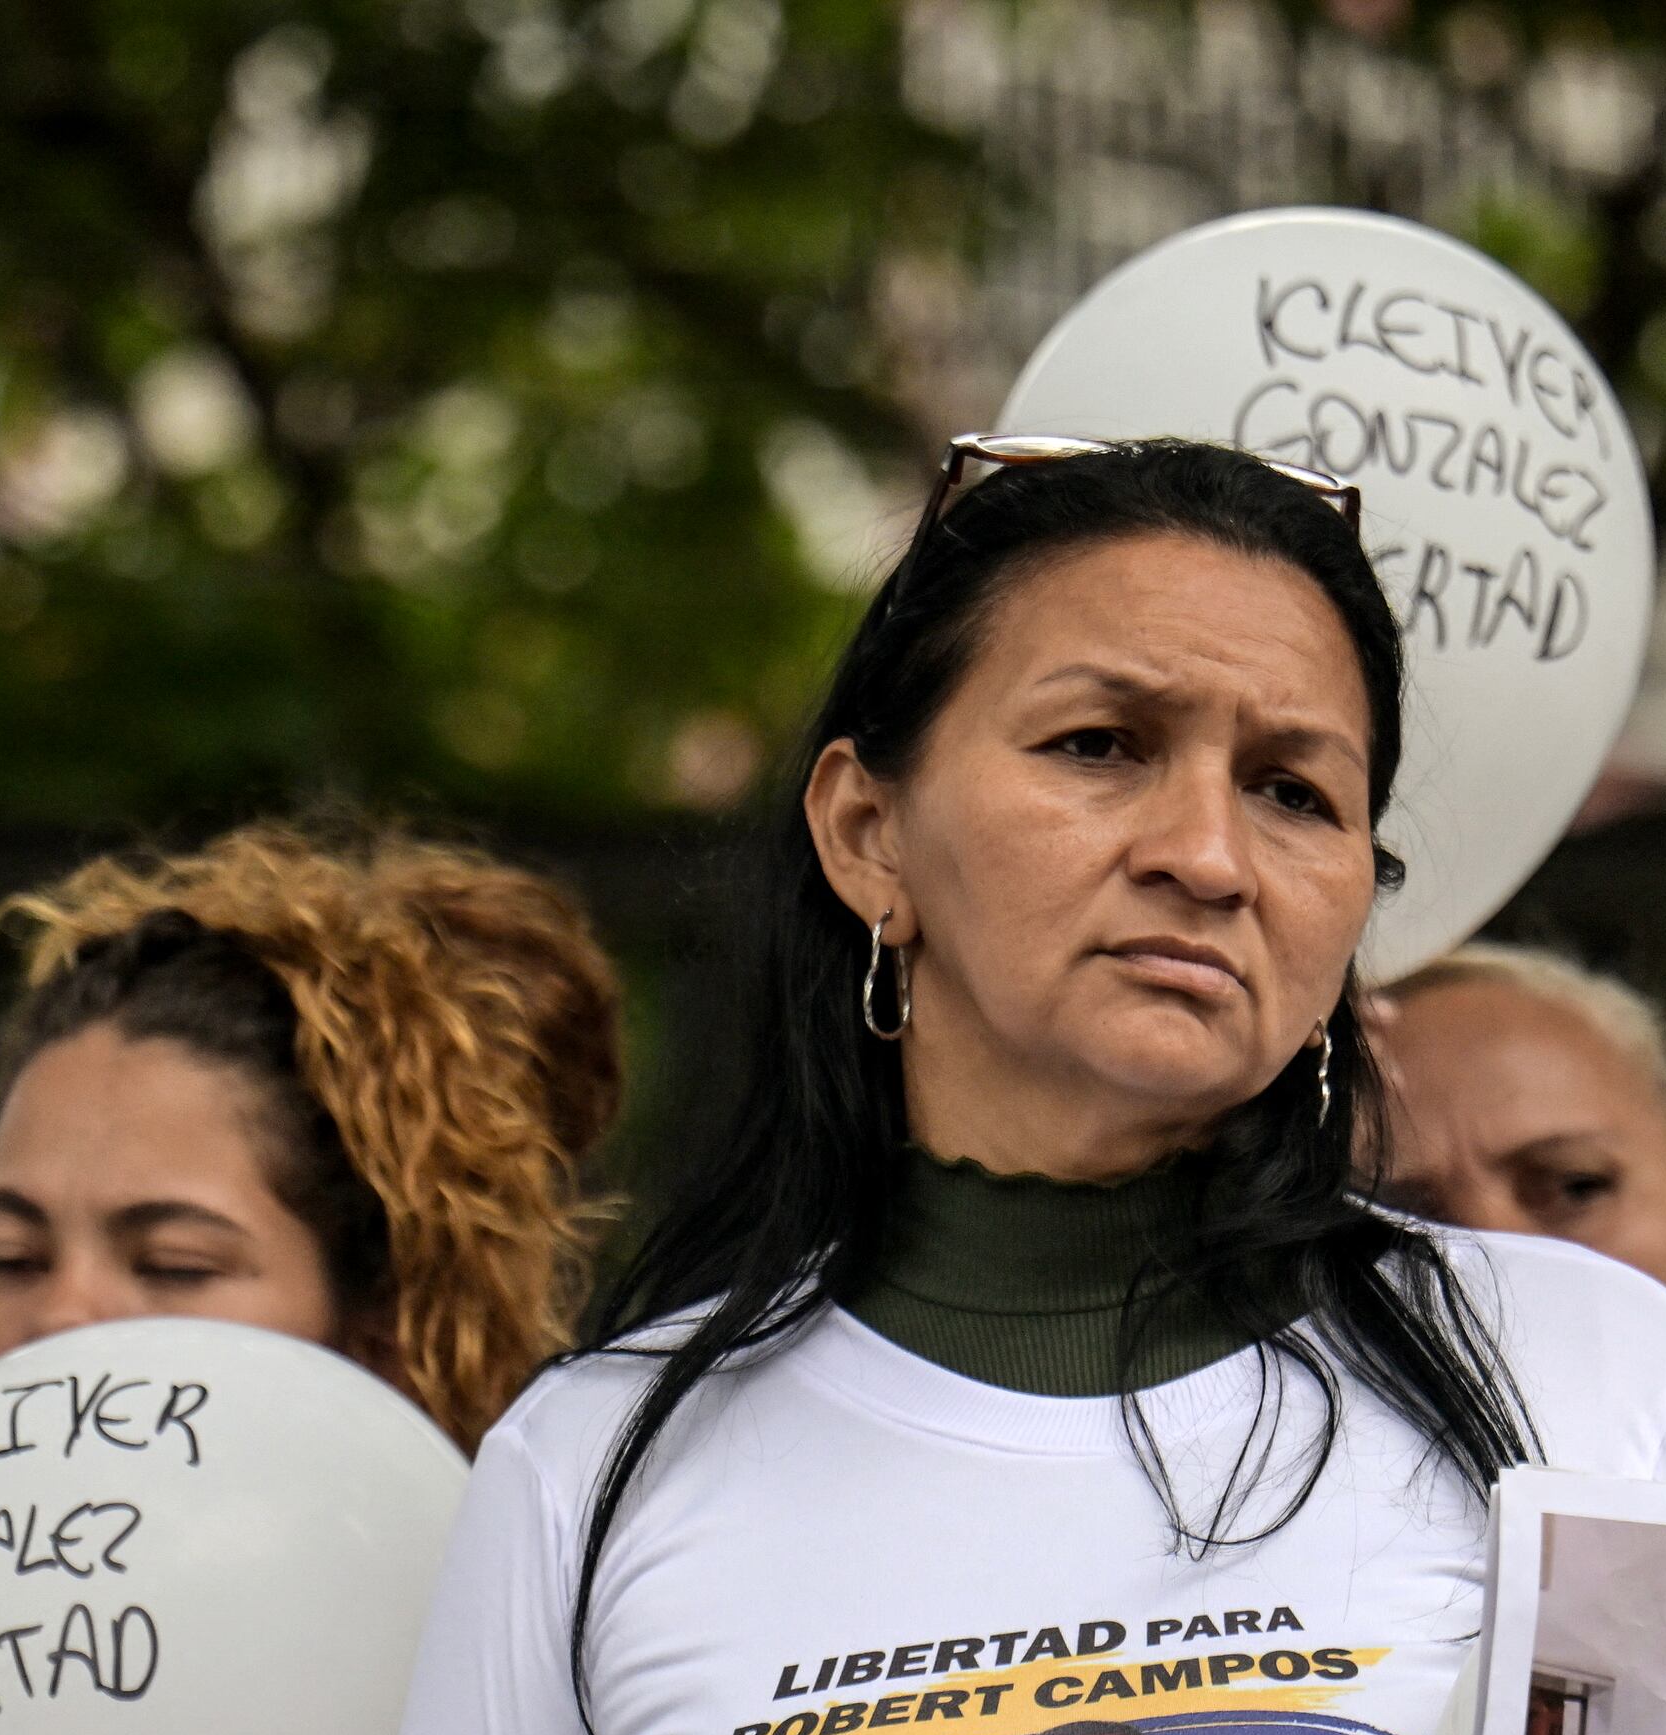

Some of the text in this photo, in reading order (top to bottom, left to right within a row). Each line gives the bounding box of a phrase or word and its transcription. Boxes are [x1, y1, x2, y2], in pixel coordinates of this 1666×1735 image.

[772, 1605, 1305, 1701] LIBERTAD PARA
[1033, 1648, 1360, 1710] CAMPOS
